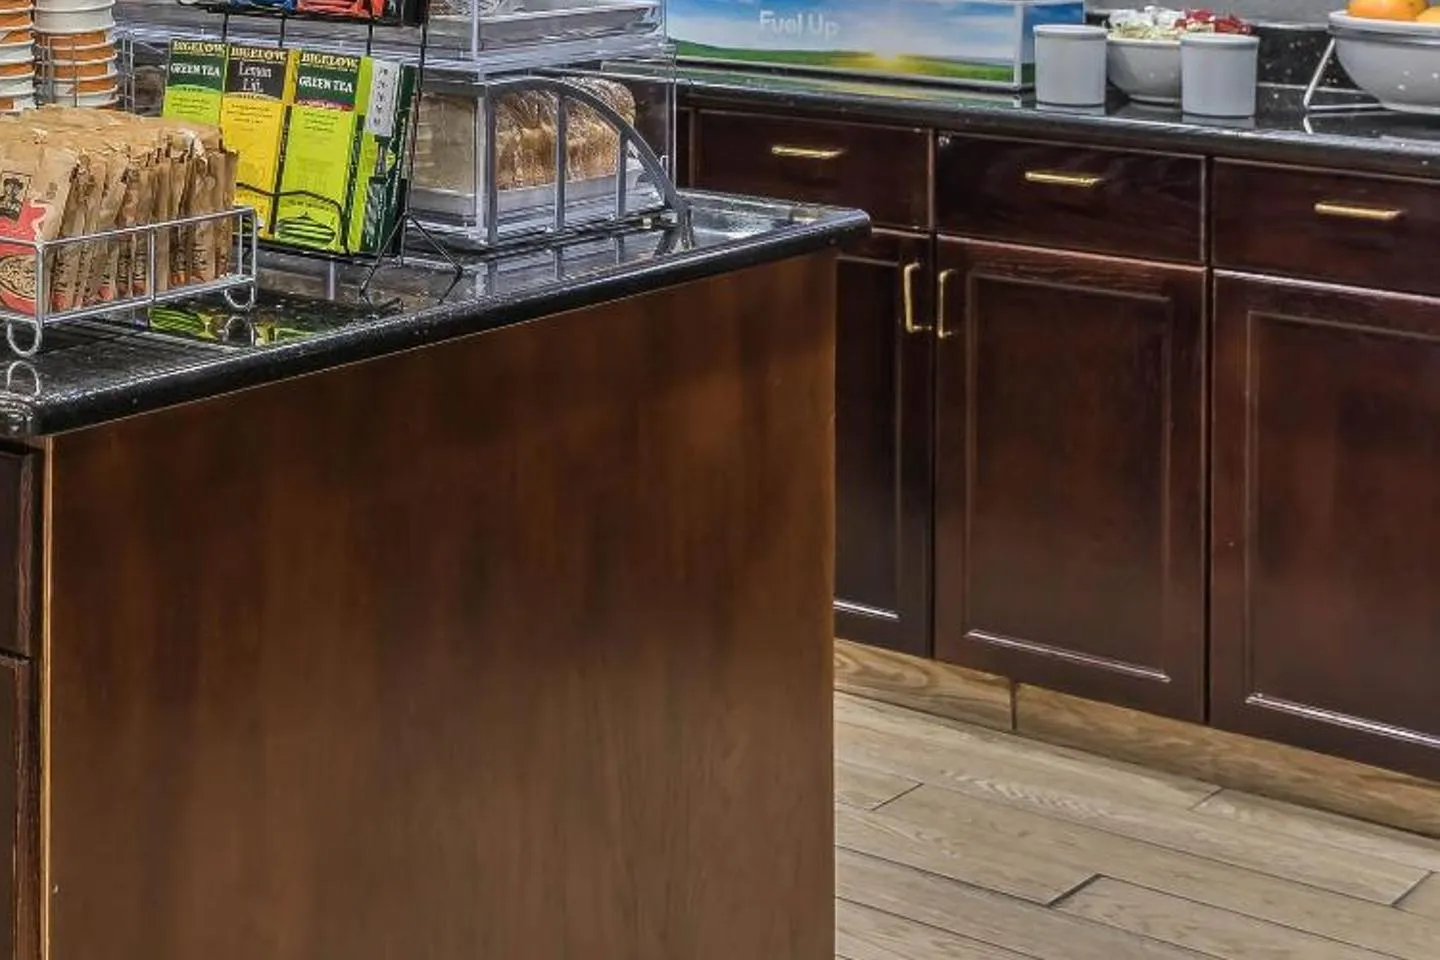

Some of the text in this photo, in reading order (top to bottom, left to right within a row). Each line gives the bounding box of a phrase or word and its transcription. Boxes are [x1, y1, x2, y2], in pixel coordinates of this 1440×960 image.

[759, 10, 840, 40] Fuel Up
[170, 63, 220, 77] GREEN TEA
[299, 76, 353, 93] GREEN TEA
